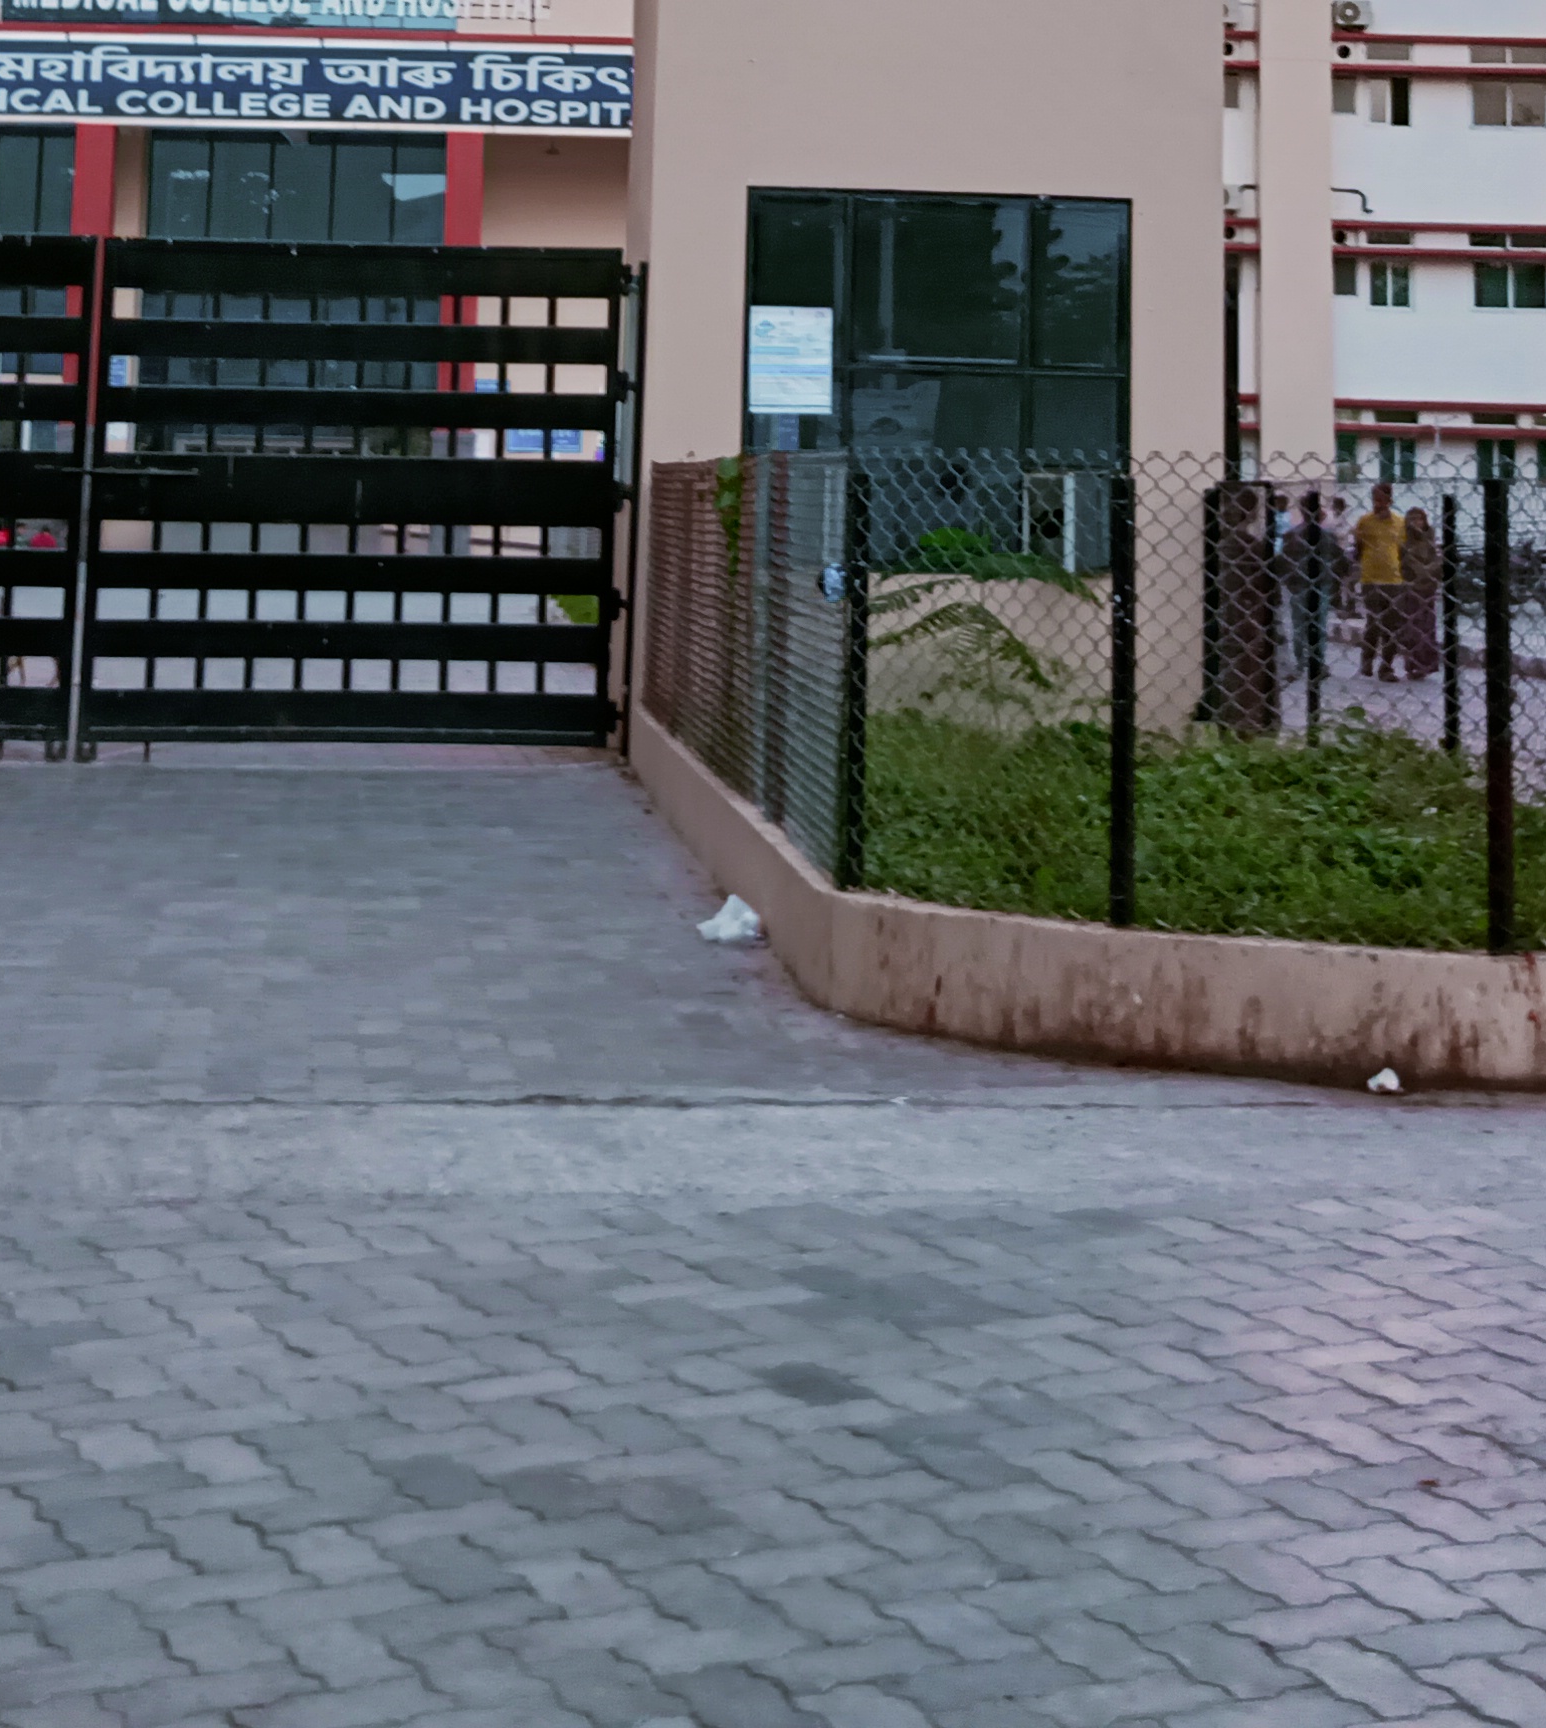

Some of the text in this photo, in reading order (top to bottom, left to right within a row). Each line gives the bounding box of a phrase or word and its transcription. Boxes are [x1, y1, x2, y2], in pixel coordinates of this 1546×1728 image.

[116, 89, 333, 119] COLLEGE
[342, 92, 447, 121] AND
[459, 97, 634, 127] HOSPIT
